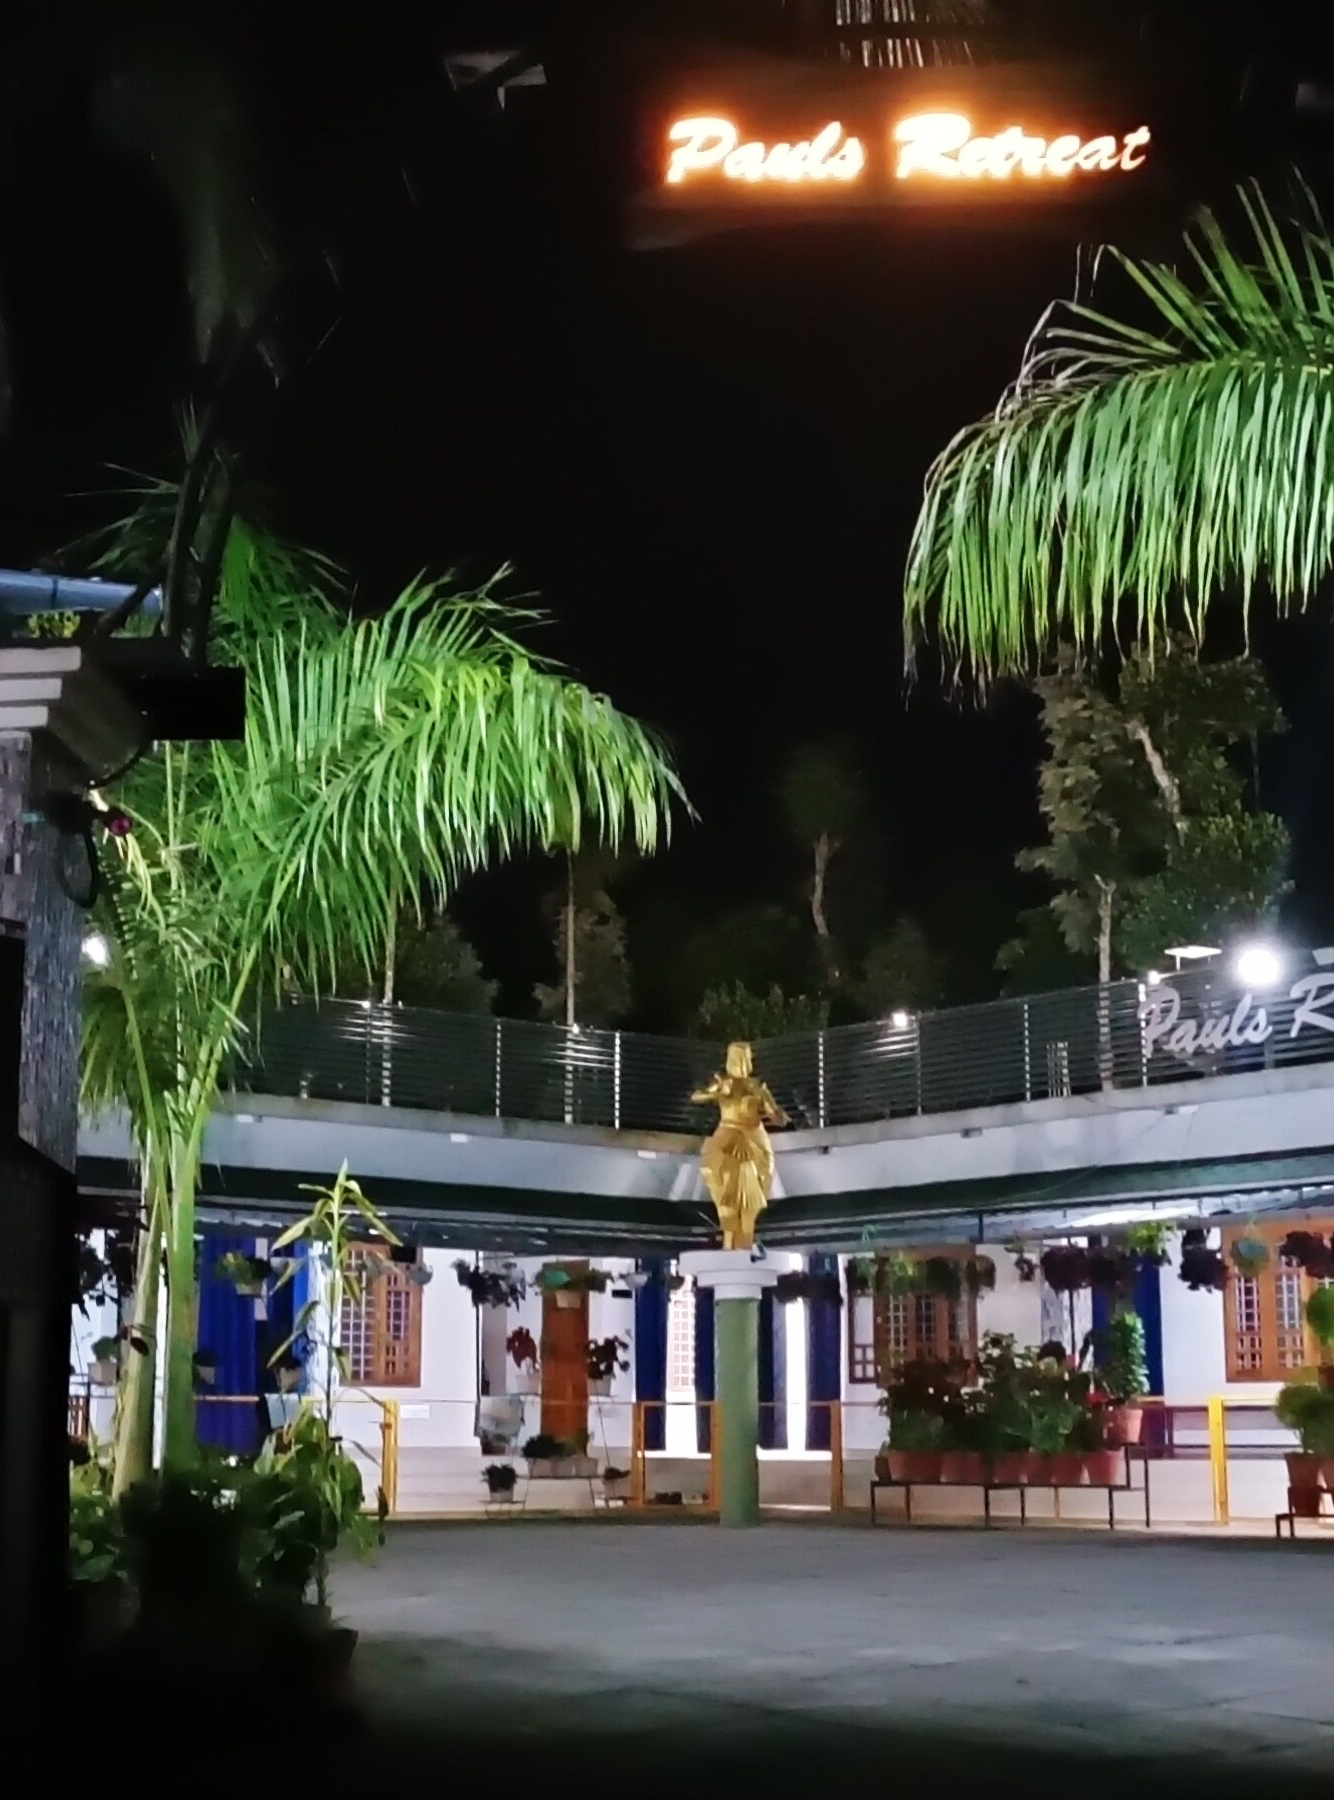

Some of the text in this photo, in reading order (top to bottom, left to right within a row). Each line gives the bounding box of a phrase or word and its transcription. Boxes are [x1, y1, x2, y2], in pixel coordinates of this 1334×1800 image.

[666, 112, 1150, 185] Pauls Retreat
[1139, 985, 1272, 1058] Pauls
